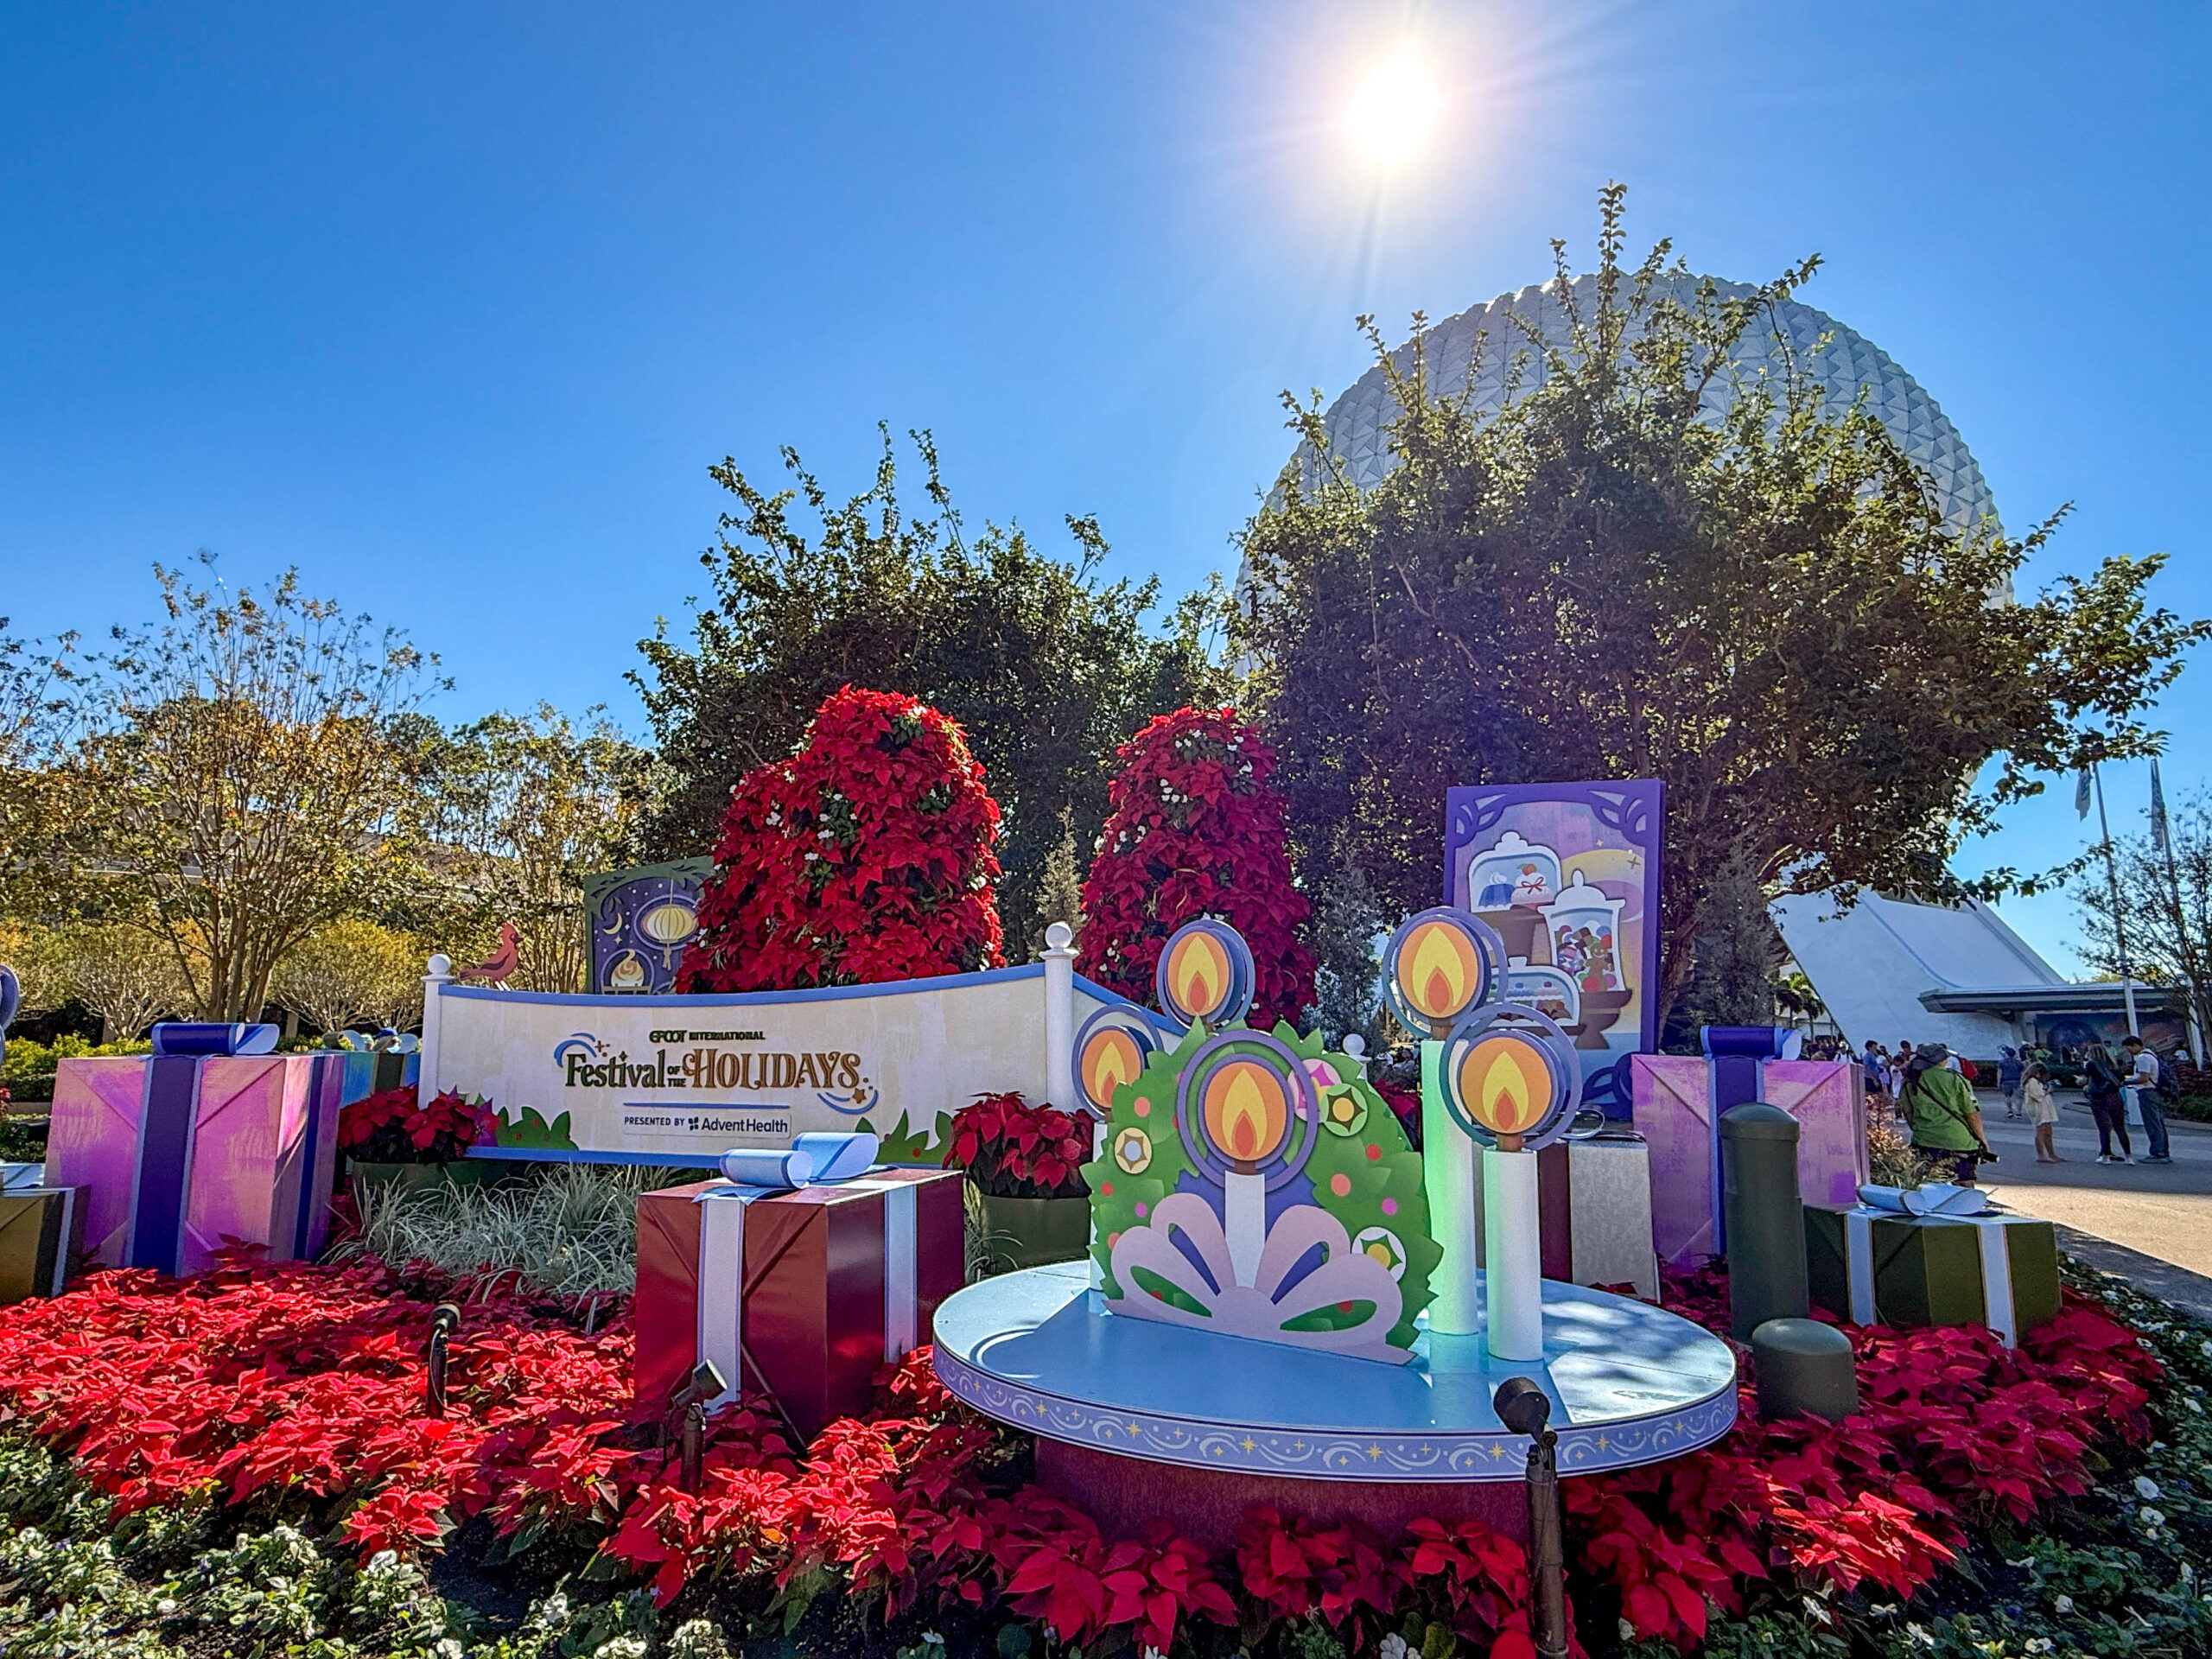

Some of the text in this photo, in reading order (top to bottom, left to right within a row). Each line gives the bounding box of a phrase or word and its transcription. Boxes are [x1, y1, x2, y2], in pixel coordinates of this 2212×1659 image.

[689, 1031, 766, 1041] INTERNATIONAL
[565, 1048, 861, 1090] Festival OF THE HOLIDAYS
[624, 1116, 788, 1133] PRESENTED BY AdventHealth
